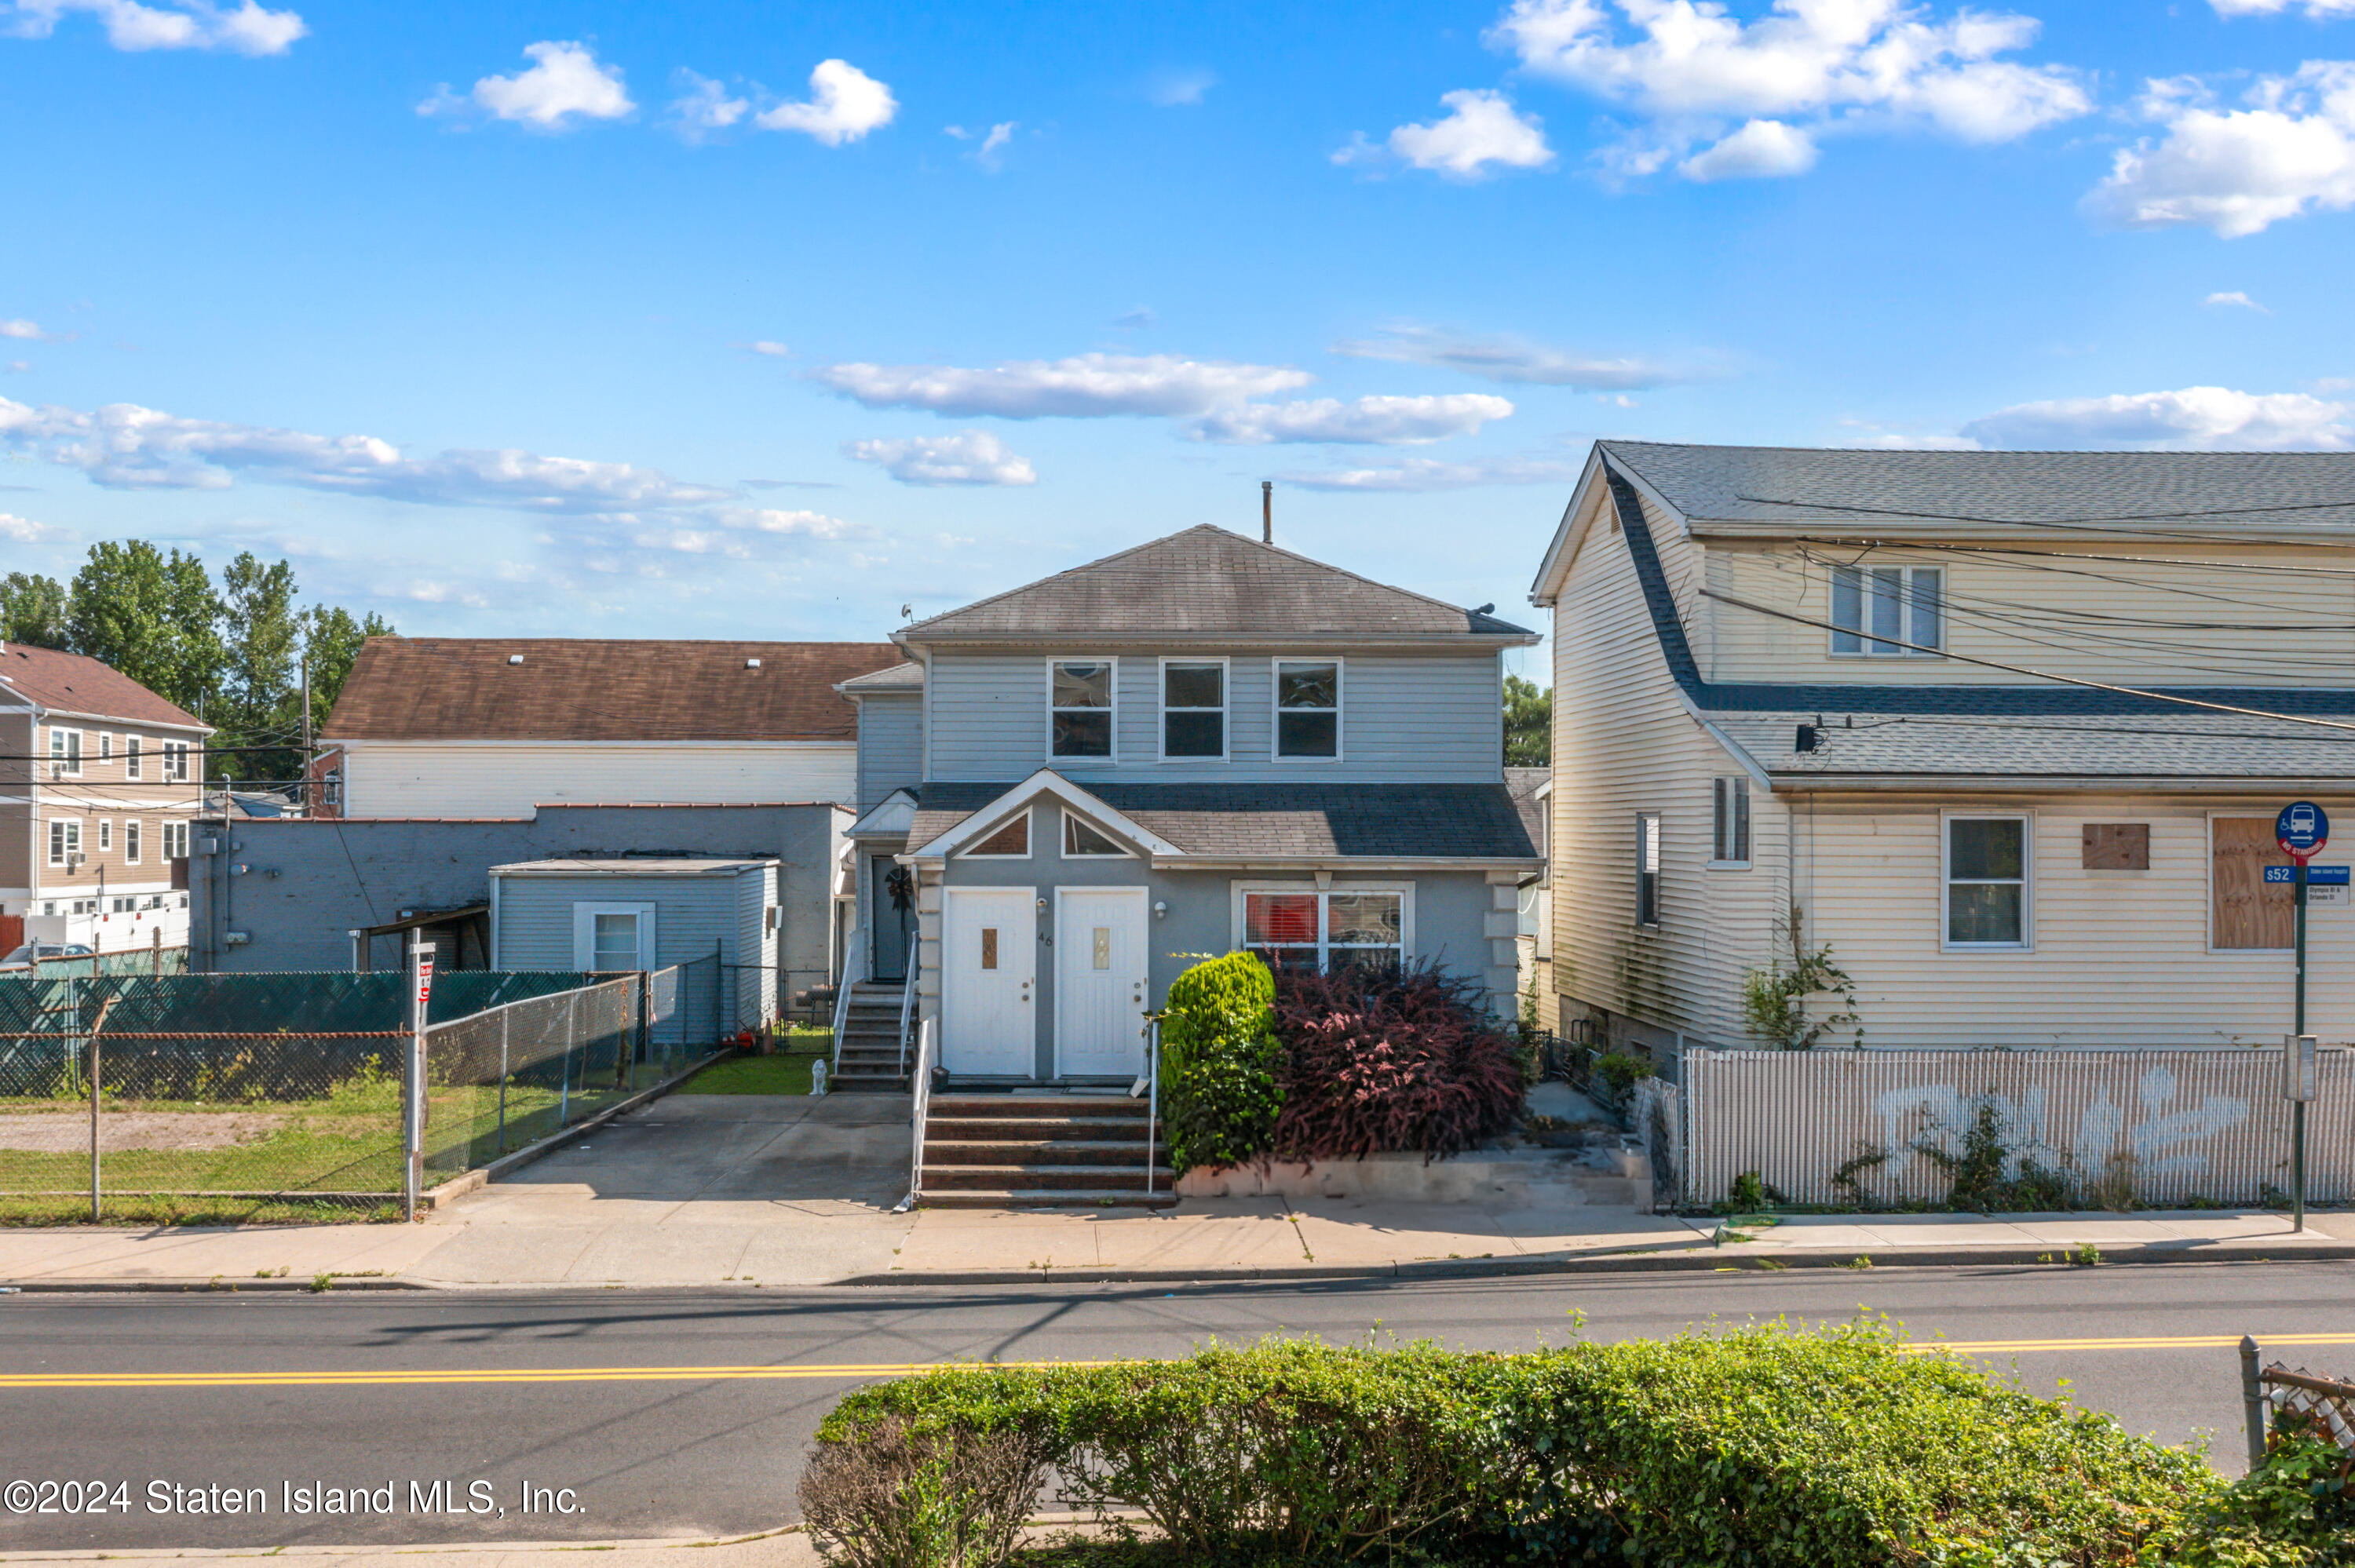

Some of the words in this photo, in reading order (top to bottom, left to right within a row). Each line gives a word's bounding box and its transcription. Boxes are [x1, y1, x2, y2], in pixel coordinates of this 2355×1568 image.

[2281, 841, 2291, 851] NO
[2291, 841, 2324, 855] STANDING
[1038, 932, 1053, 947] 46
